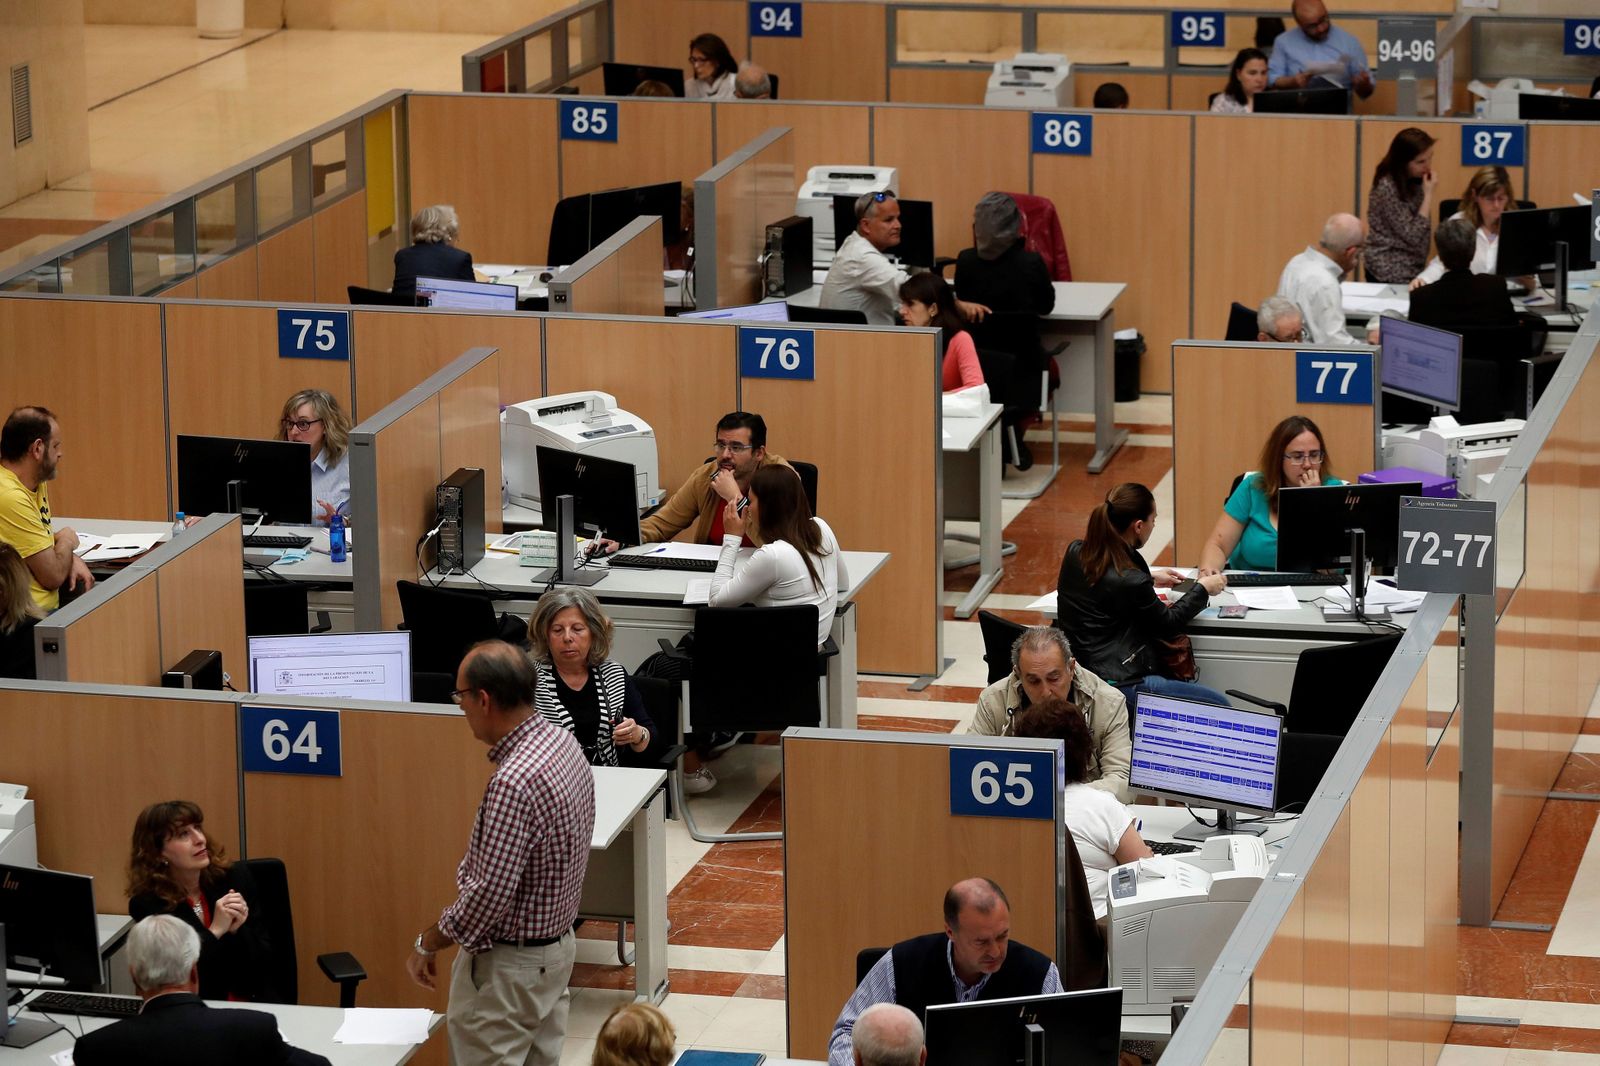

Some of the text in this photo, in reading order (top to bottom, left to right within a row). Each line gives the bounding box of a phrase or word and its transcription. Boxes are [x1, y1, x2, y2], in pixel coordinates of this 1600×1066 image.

[760, 7, 794, 31] 94
[1181, 16, 1216, 41] 95
[1378, 39, 1436, 62] 94-96
[572, 107, 608, 135] 85
[1043, 119, 1081, 148] 86
[1473, 131, 1513, 159] 87
[291, 318, 336, 351] 75
[755, 337, 800, 371] 76
[1311, 361, 1358, 395] 77
[1402, 530, 1493, 568] 72-77
[262, 718, 322, 763] 64
[971, 760, 1034, 806] 65
